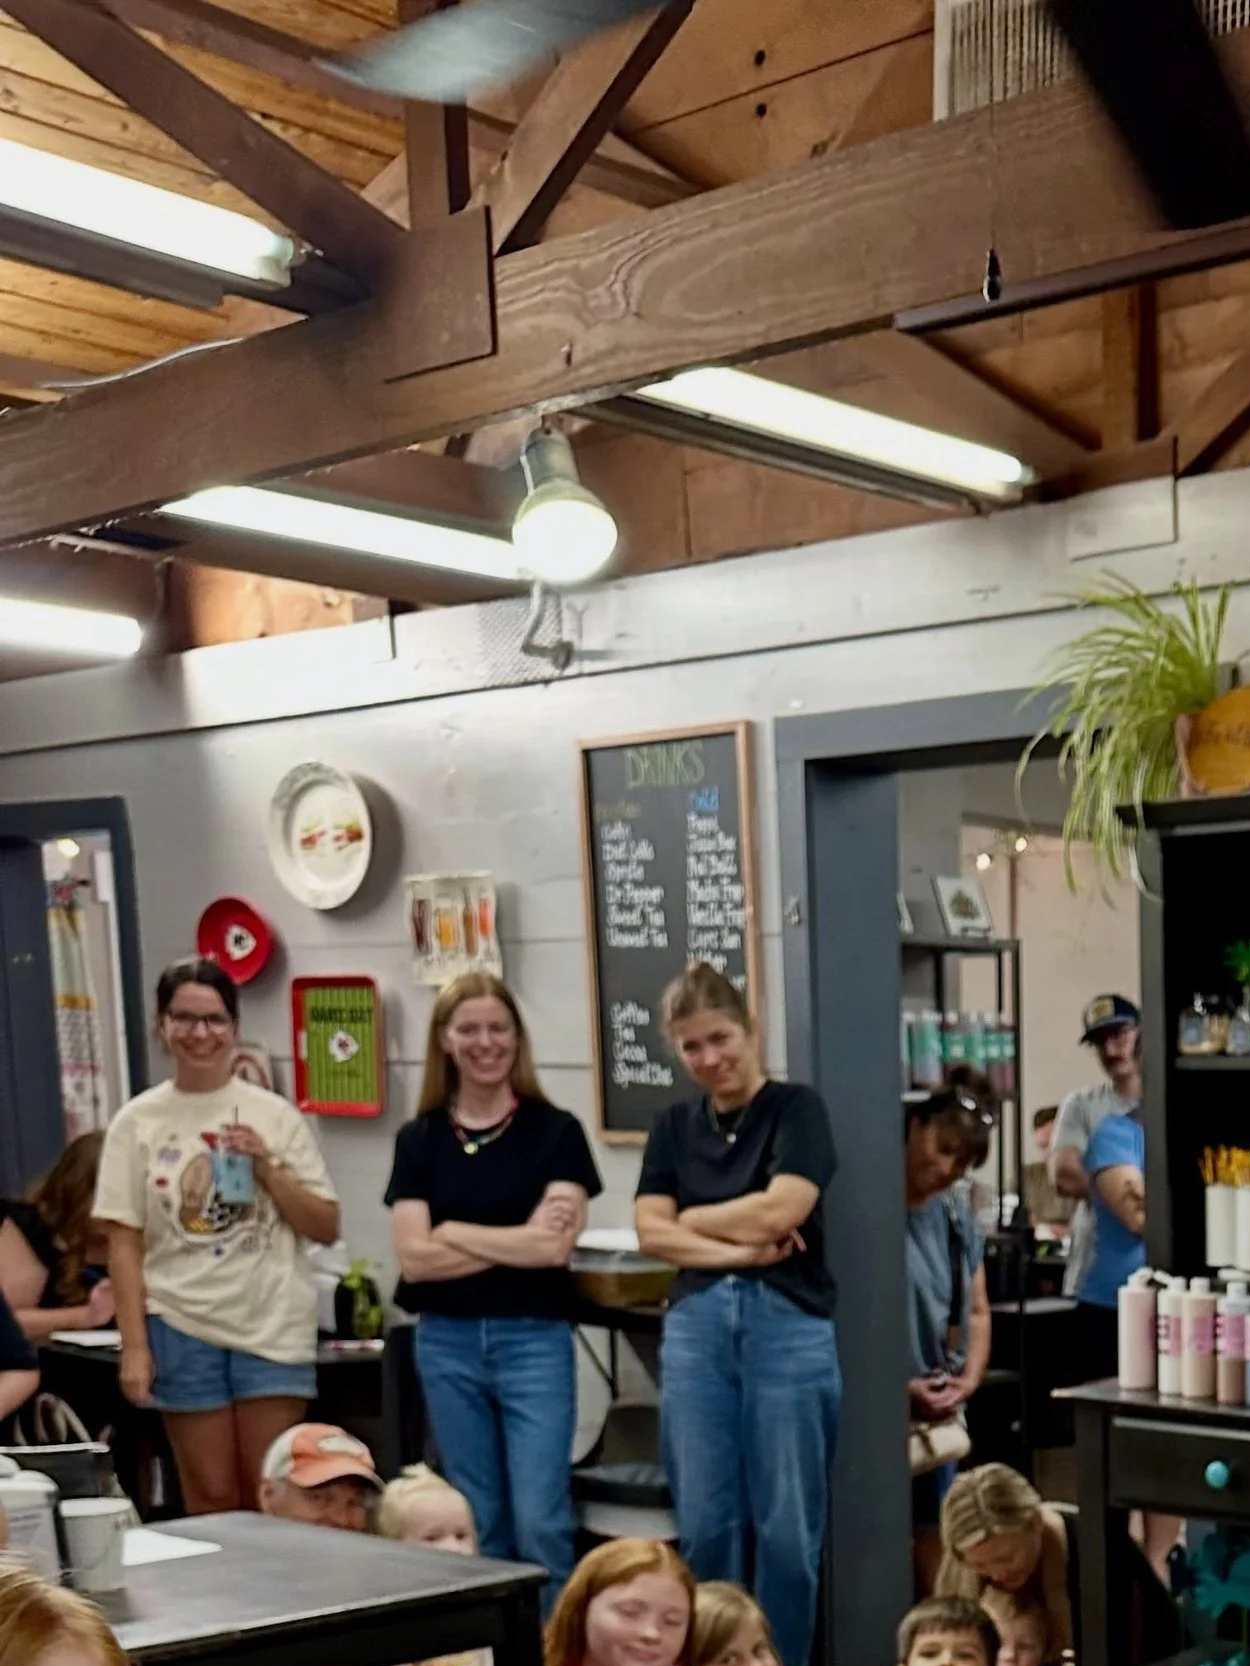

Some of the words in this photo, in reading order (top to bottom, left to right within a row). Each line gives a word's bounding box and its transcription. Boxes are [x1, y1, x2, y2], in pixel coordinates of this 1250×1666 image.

[625, 743, 705, 789] DRINKS
[644, 904, 665, 926] Tea
[610, 1001, 650, 1027] Coffee
